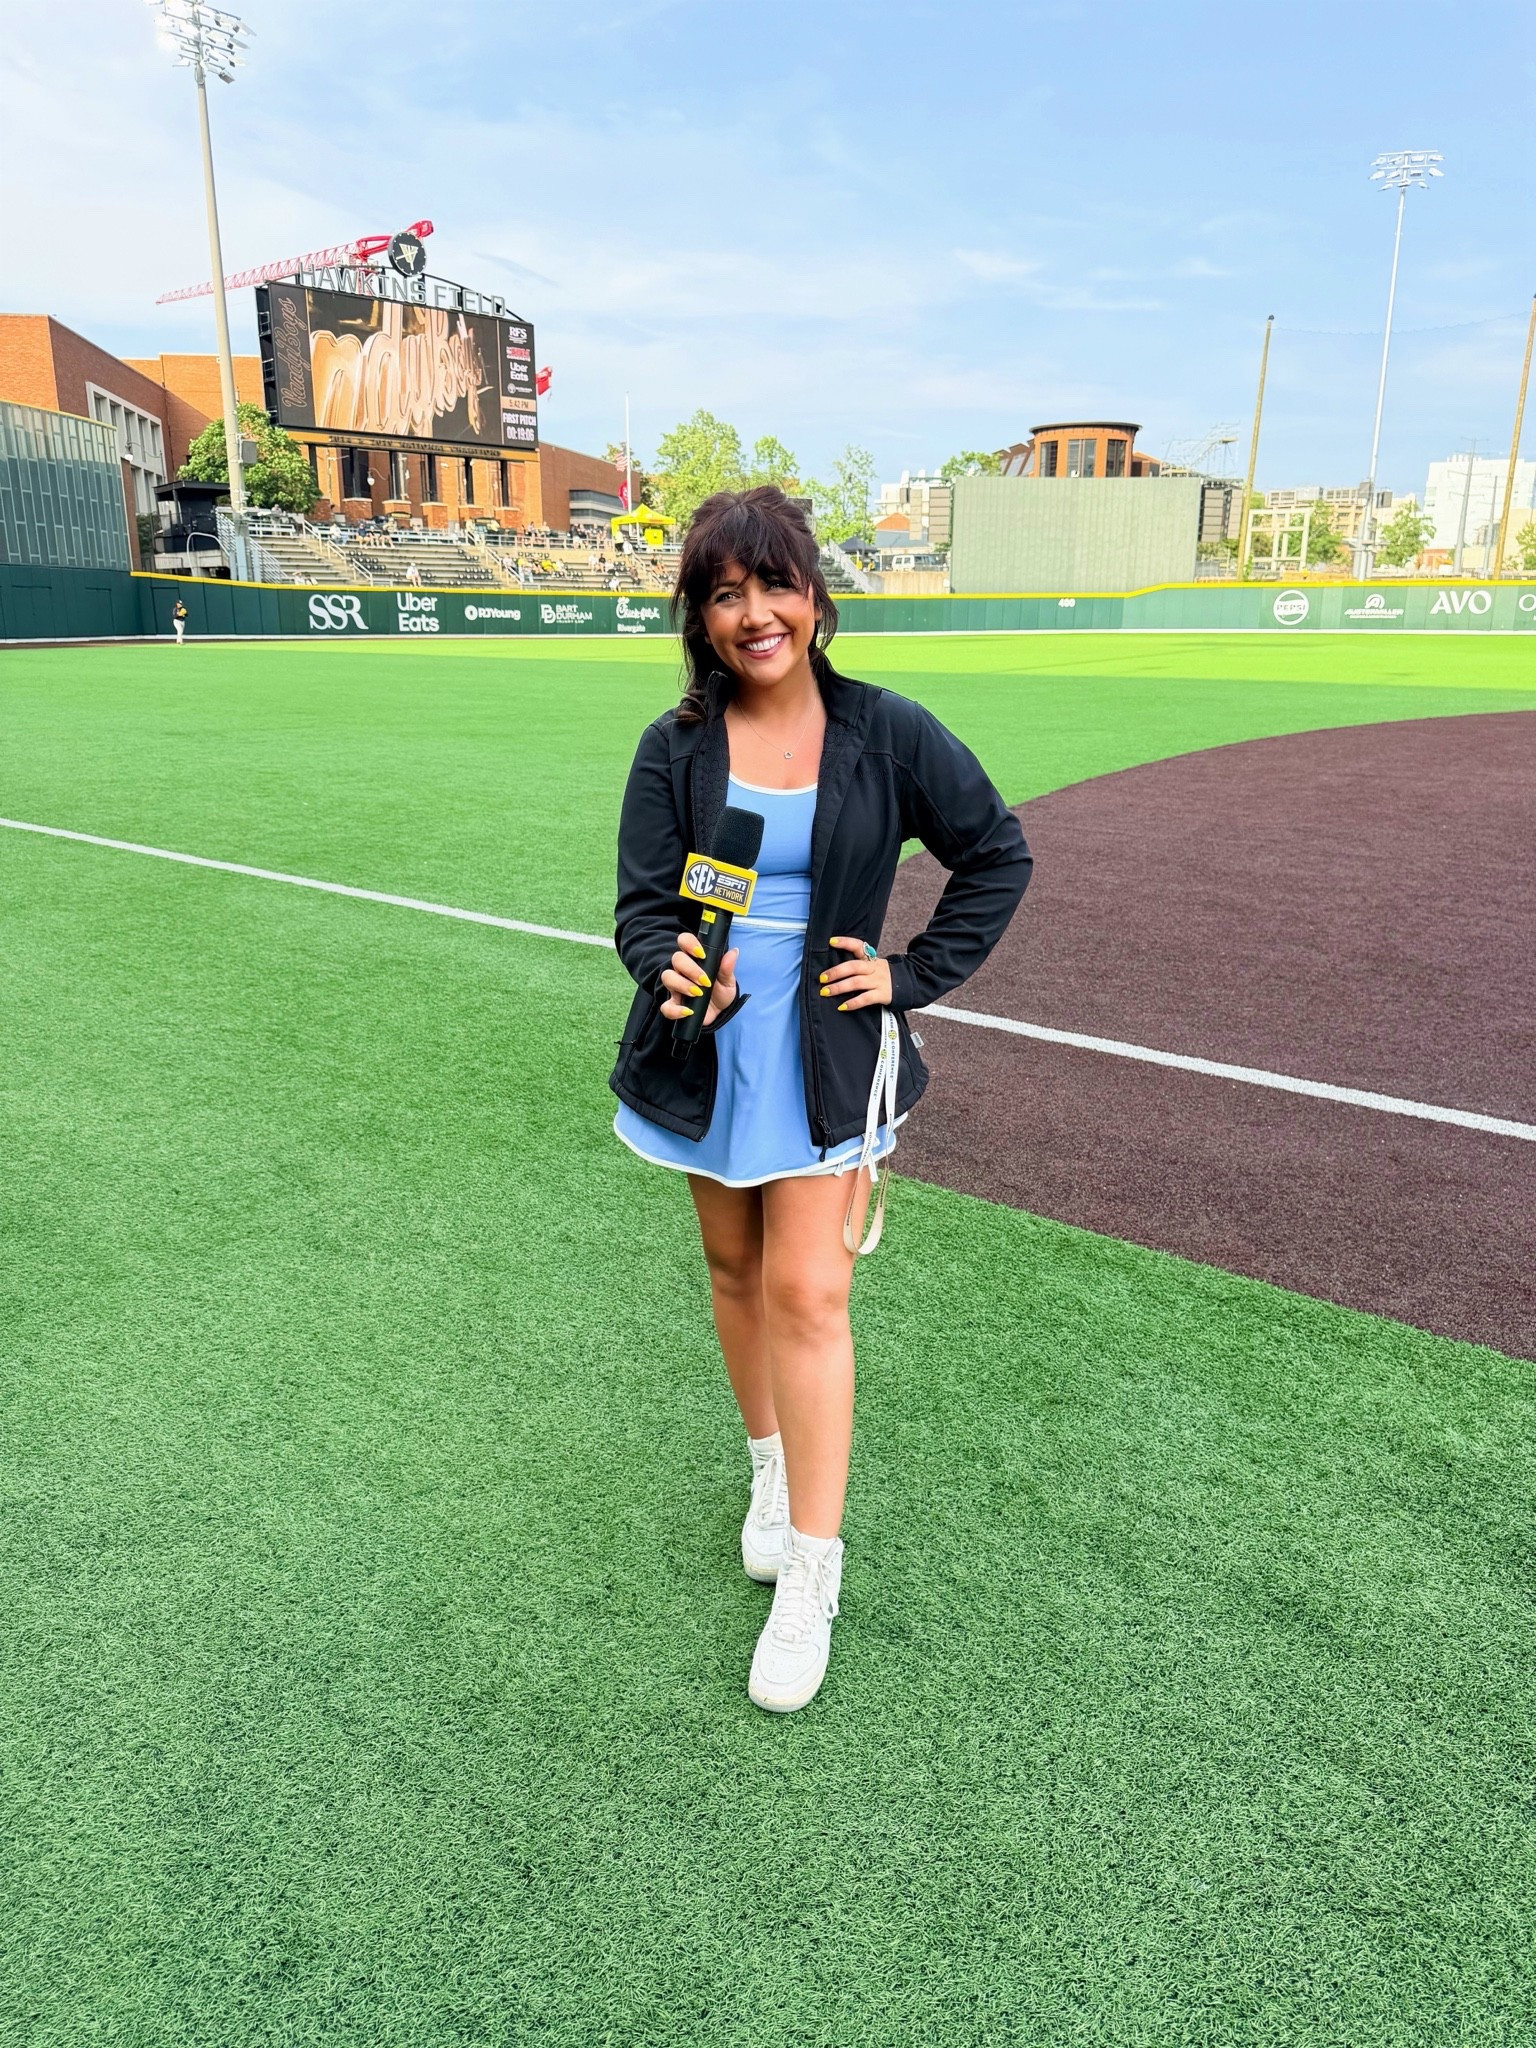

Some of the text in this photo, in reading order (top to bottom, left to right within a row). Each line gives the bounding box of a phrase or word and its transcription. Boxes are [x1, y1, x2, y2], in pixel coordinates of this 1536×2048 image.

[299, 262, 505, 317] HAWKINS FIELD
[509, 326, 527, 338] RFS
[510, 362, 528, 373] Uber
[510, 372, 528, 382] Eats
[521, 401, 529, 409] PM
[502, 412, 537, 426] FIRST PITCH
[396, 592, 438, 612] Uber
[555, 604, 578, 613] BART
[1058, 598, 1076, 608] 400
[1276, 603, 1306, 611] PEPSI
[1429, 590, 1492, 615] AVO
[308, 594, 369, 630] SSR
[556, 612, 593, 620] DURHAM
[399, 612, 440, 632] Eats
[688, 863, 716, 895] SEC
[716, 874, 747, 891] ESPN
[714, 886, 744, 903] NETWORK
